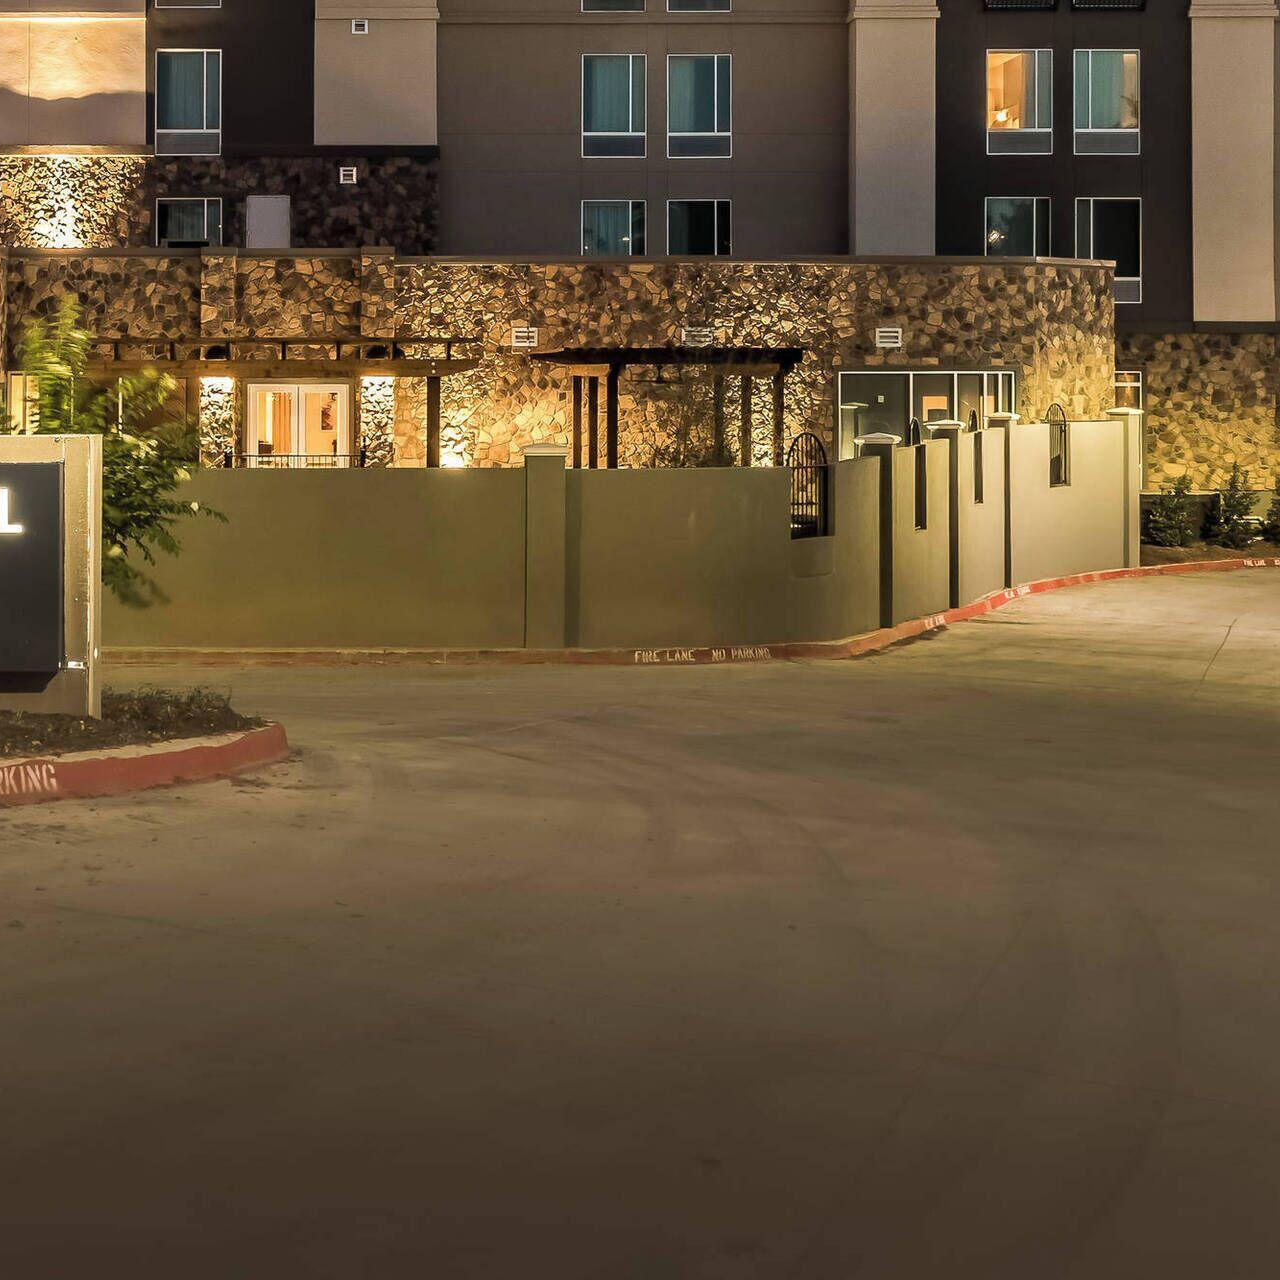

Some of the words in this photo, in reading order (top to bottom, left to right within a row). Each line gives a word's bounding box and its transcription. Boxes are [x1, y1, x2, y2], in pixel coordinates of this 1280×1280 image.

[634, 649, 660, 663] FIRE
[666, 648, 696, 662] LANE
[711, 648, 726, 662] NO
[731, 647, 771, 659] PARKING
